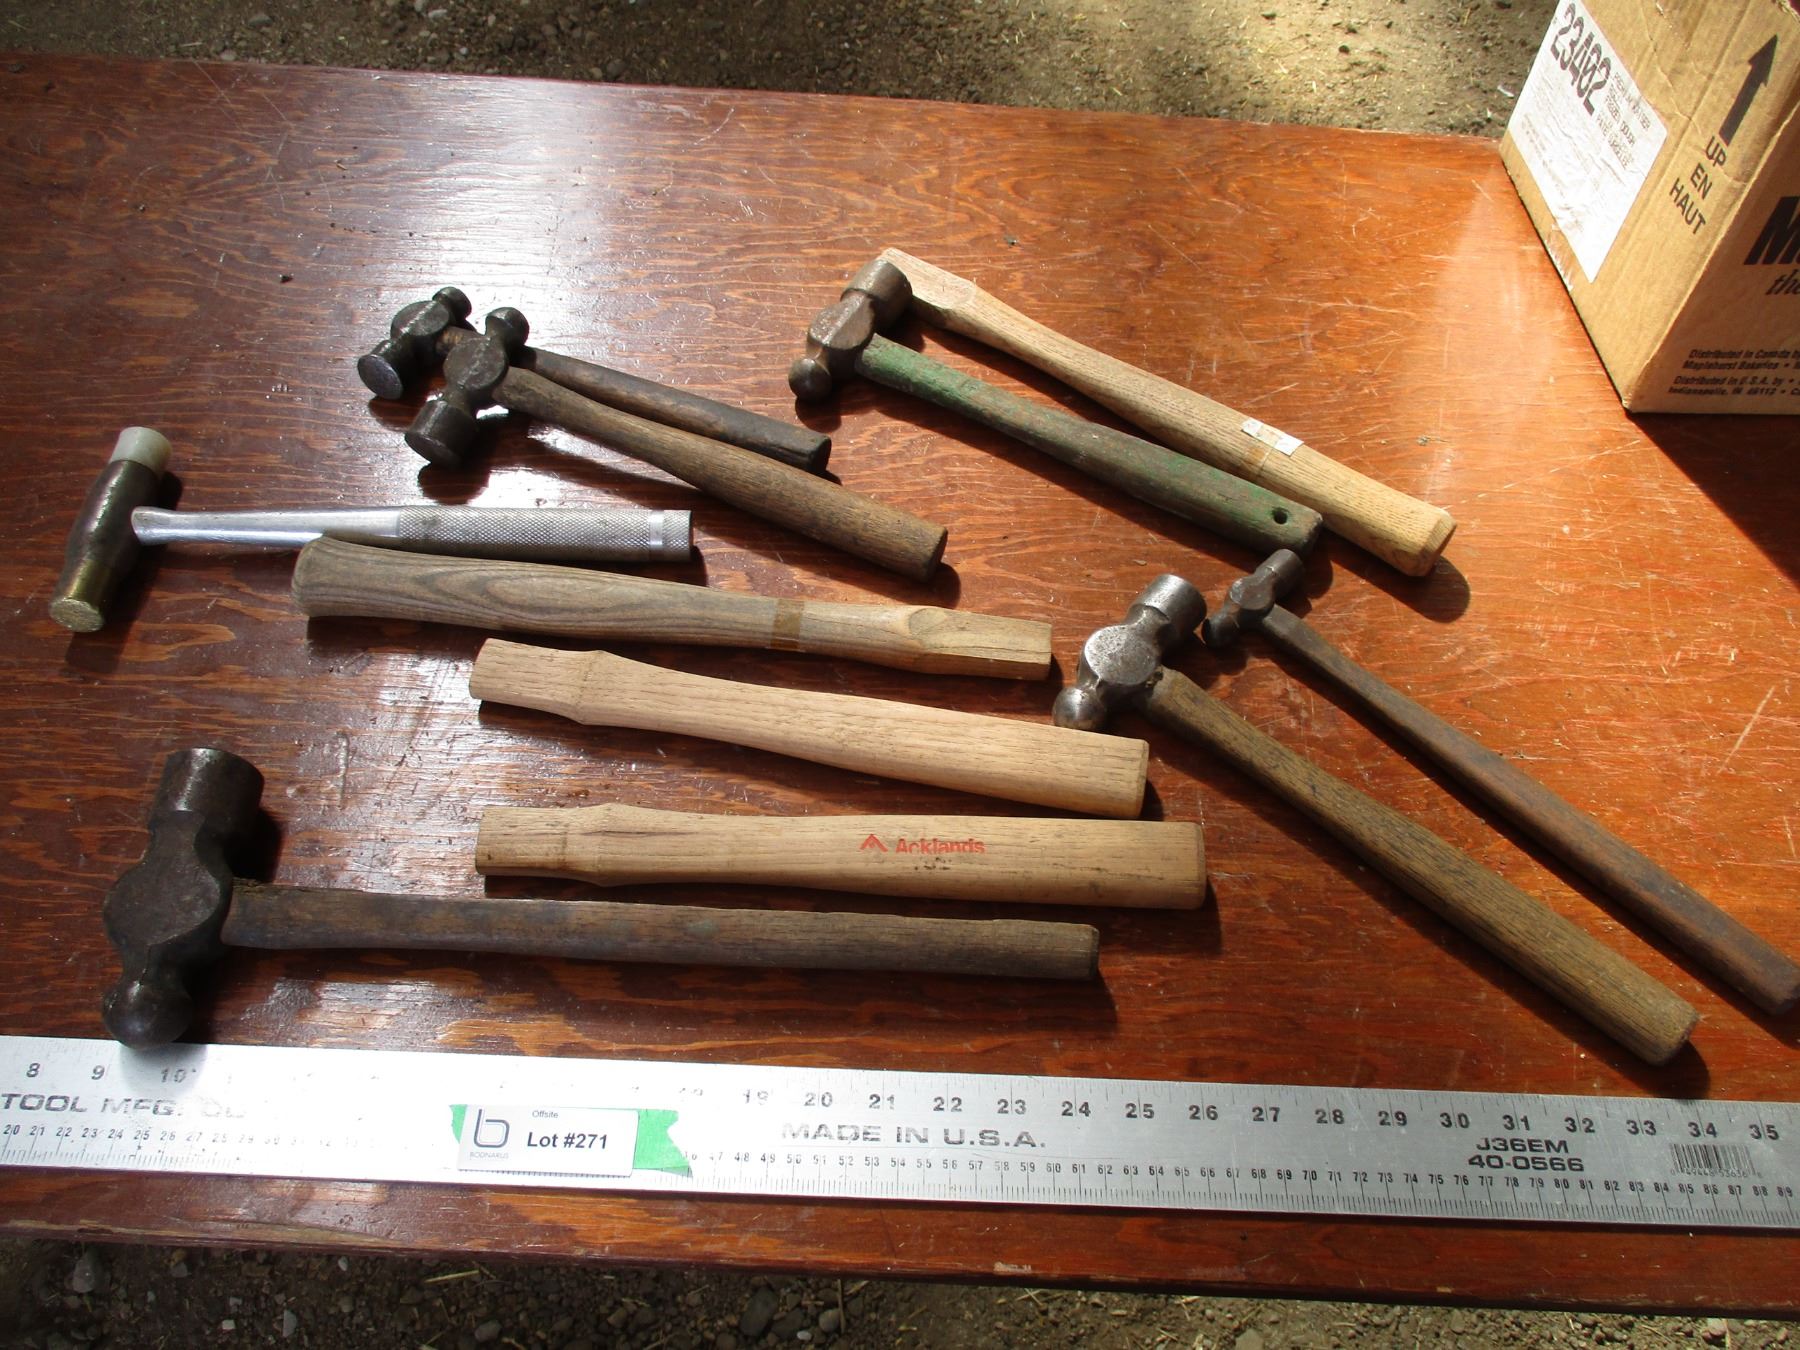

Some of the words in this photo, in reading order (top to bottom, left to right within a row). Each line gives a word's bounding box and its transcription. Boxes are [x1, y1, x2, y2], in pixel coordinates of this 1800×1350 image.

[1551, 3, 1611, 116] 23402
[1704, 136, 1727, 168] UP
[1691, 163, 1713, 199] EN
[1669, 177, 1706, 235] HAUT
[895, 838, 985, 853] Acklands
[1, 1093, 88, 1112] TOOL
[26, 1063, 41, 1077] 8
[91, 1065, 105, 1080] 9
[805, 1092, 833, 1108] 20
[869, 1094, 896, 1110] 21
[933, 1096, 962, 1112] 22
[997, 1098, 1027, 1115] 23
[1061, 1101, 1091, 1117] 24
[1125, 1102, 1155, 1120] 25
[1189, 1104, 1218, 1121] 26
[1252, 1106, 1280, 1123] 27
[1315, 1109, 1345, 1125] 28
[1378, 1110, 1407, 1127] 29
[1440, 1112, 1469, 1129] 30
[1503, 1114, 1530, 1131] 31
[1565, 1117, 1596, 1133] 32
[1627, 1120, 1657, 1136] 33
[1688, 1122, 1718, 1138] 34
[1749, 1124, 1780, 1141] 35
[532, 1109, 559, 1119] Offsite
[3, 1125, 20, 1135] 20
[29, 1125, 45, 1136] 21
[56, 1127, 72, 1137] 22
[82, 1128, 98, 1138] 23
[108, 1128, 122, 1139] 24
[134, 1129, 150, 1140] 25
[160, 1130, 176, 1141] 26
[527, 1131, 559, 1149] Lot
[563, 1132, 608, 1150] #271
[783, 1123, 882, 1142] MADE
[896, 1126, 929, 1144] IN
[944, 1128, 1046, 1148] U.S.A.
[1476, 1137, 1569, 1154] J36EM
[1468, 1154, 1584, 1172] 40-0566
[735, 1152, 750, 1163] 48
[761, 1153, 776, 1163] 49
[839, 1156, 854, 1166] 52
[864, 1157, 879, 1167] 53
[890, 1157, 906, 1167] 54
[917, 1158, 932, 1168] 55
[943, 1159, 958, 1169] 56
[969, 1160, 983, 1170] 57
[1020, 1162, 1035, 1172] 59
[1072, 1163, 1086, 1174] 61
[1098, 1164, 1113, 1175] 62
[1123, 1165, 1138, 1175] 63
[1200, 1167, 1215, 1178] 66
[1226, 1168, 1240, 1178] 67
[1251, 1168, 1267, 1179] 68
[1277, 1169, 1292, 1180] 69
[1303, 1170, 1318, 1181] 70
[1328, 1171, 1342, 1182] 71
[1353, 1172, 1368, 1182] 72
[1377, 1173, 1393, 1183] 73
[1403, 1173, 1419, 1184] 74
[1429, 1174, 1444, 1185] 75
[1453, 1175, 1469, 1186] 76
[1479, 1176, 1494, 1187] 77
[1504, 1176, 1520, 1188] 78
[1529, 1177, 1544, 1188] 79
[1554, 1178, 1570, 1190] 80
[1579, 1179, 1594, 1190] 81
[1604, 1180, 1620, 1192] 82
[1629, 1181, 1645, 1193] 83
[1654, 1182, 1670, 1193] 84
[1679, 1182, 1694, 1194] 85
[1703, 1183, 1719, 1195] 86
[1728, 1184, 1743, 1196] 87
[1753, 1185, 1769, 1197] 88
[1777, 1186, 1793, 1198] 89
